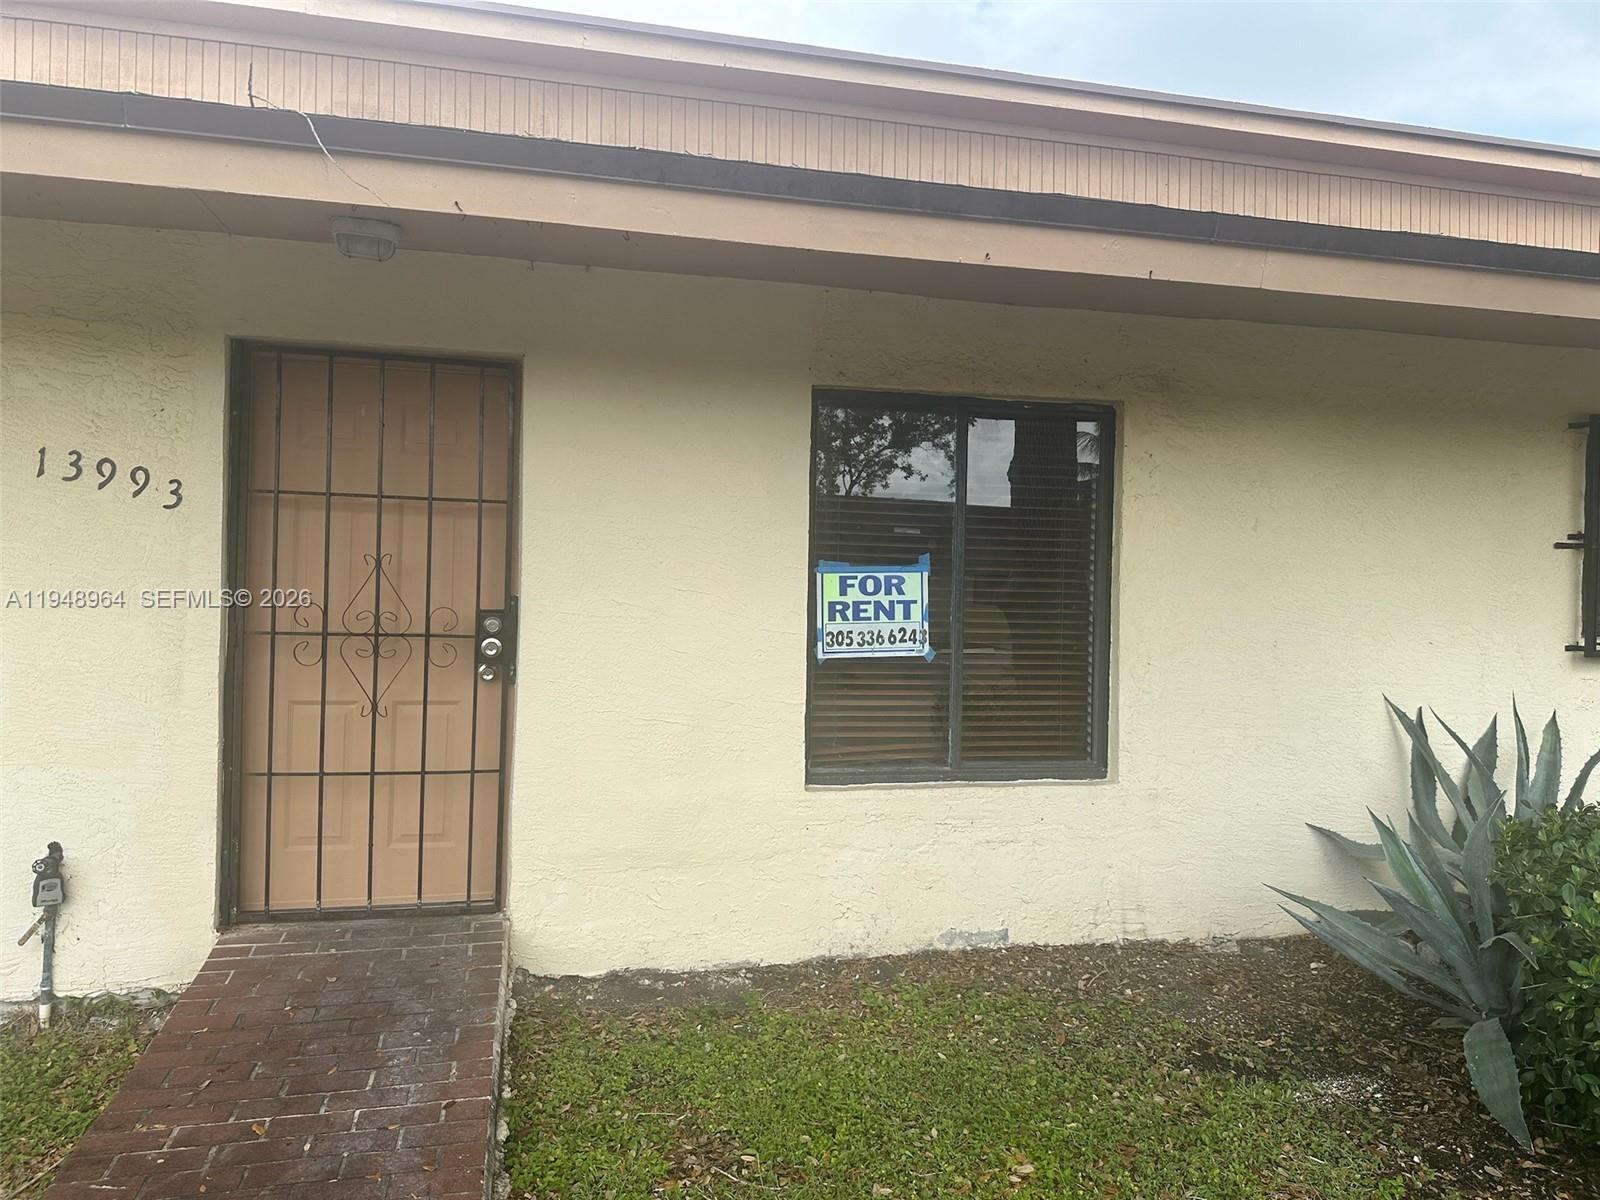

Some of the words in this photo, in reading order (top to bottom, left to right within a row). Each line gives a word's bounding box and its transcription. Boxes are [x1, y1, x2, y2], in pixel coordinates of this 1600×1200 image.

[36, 446, 184, 510] 13993
[838, 574, 906, 597] FOR
[827, 599, 918, 622] RENT
